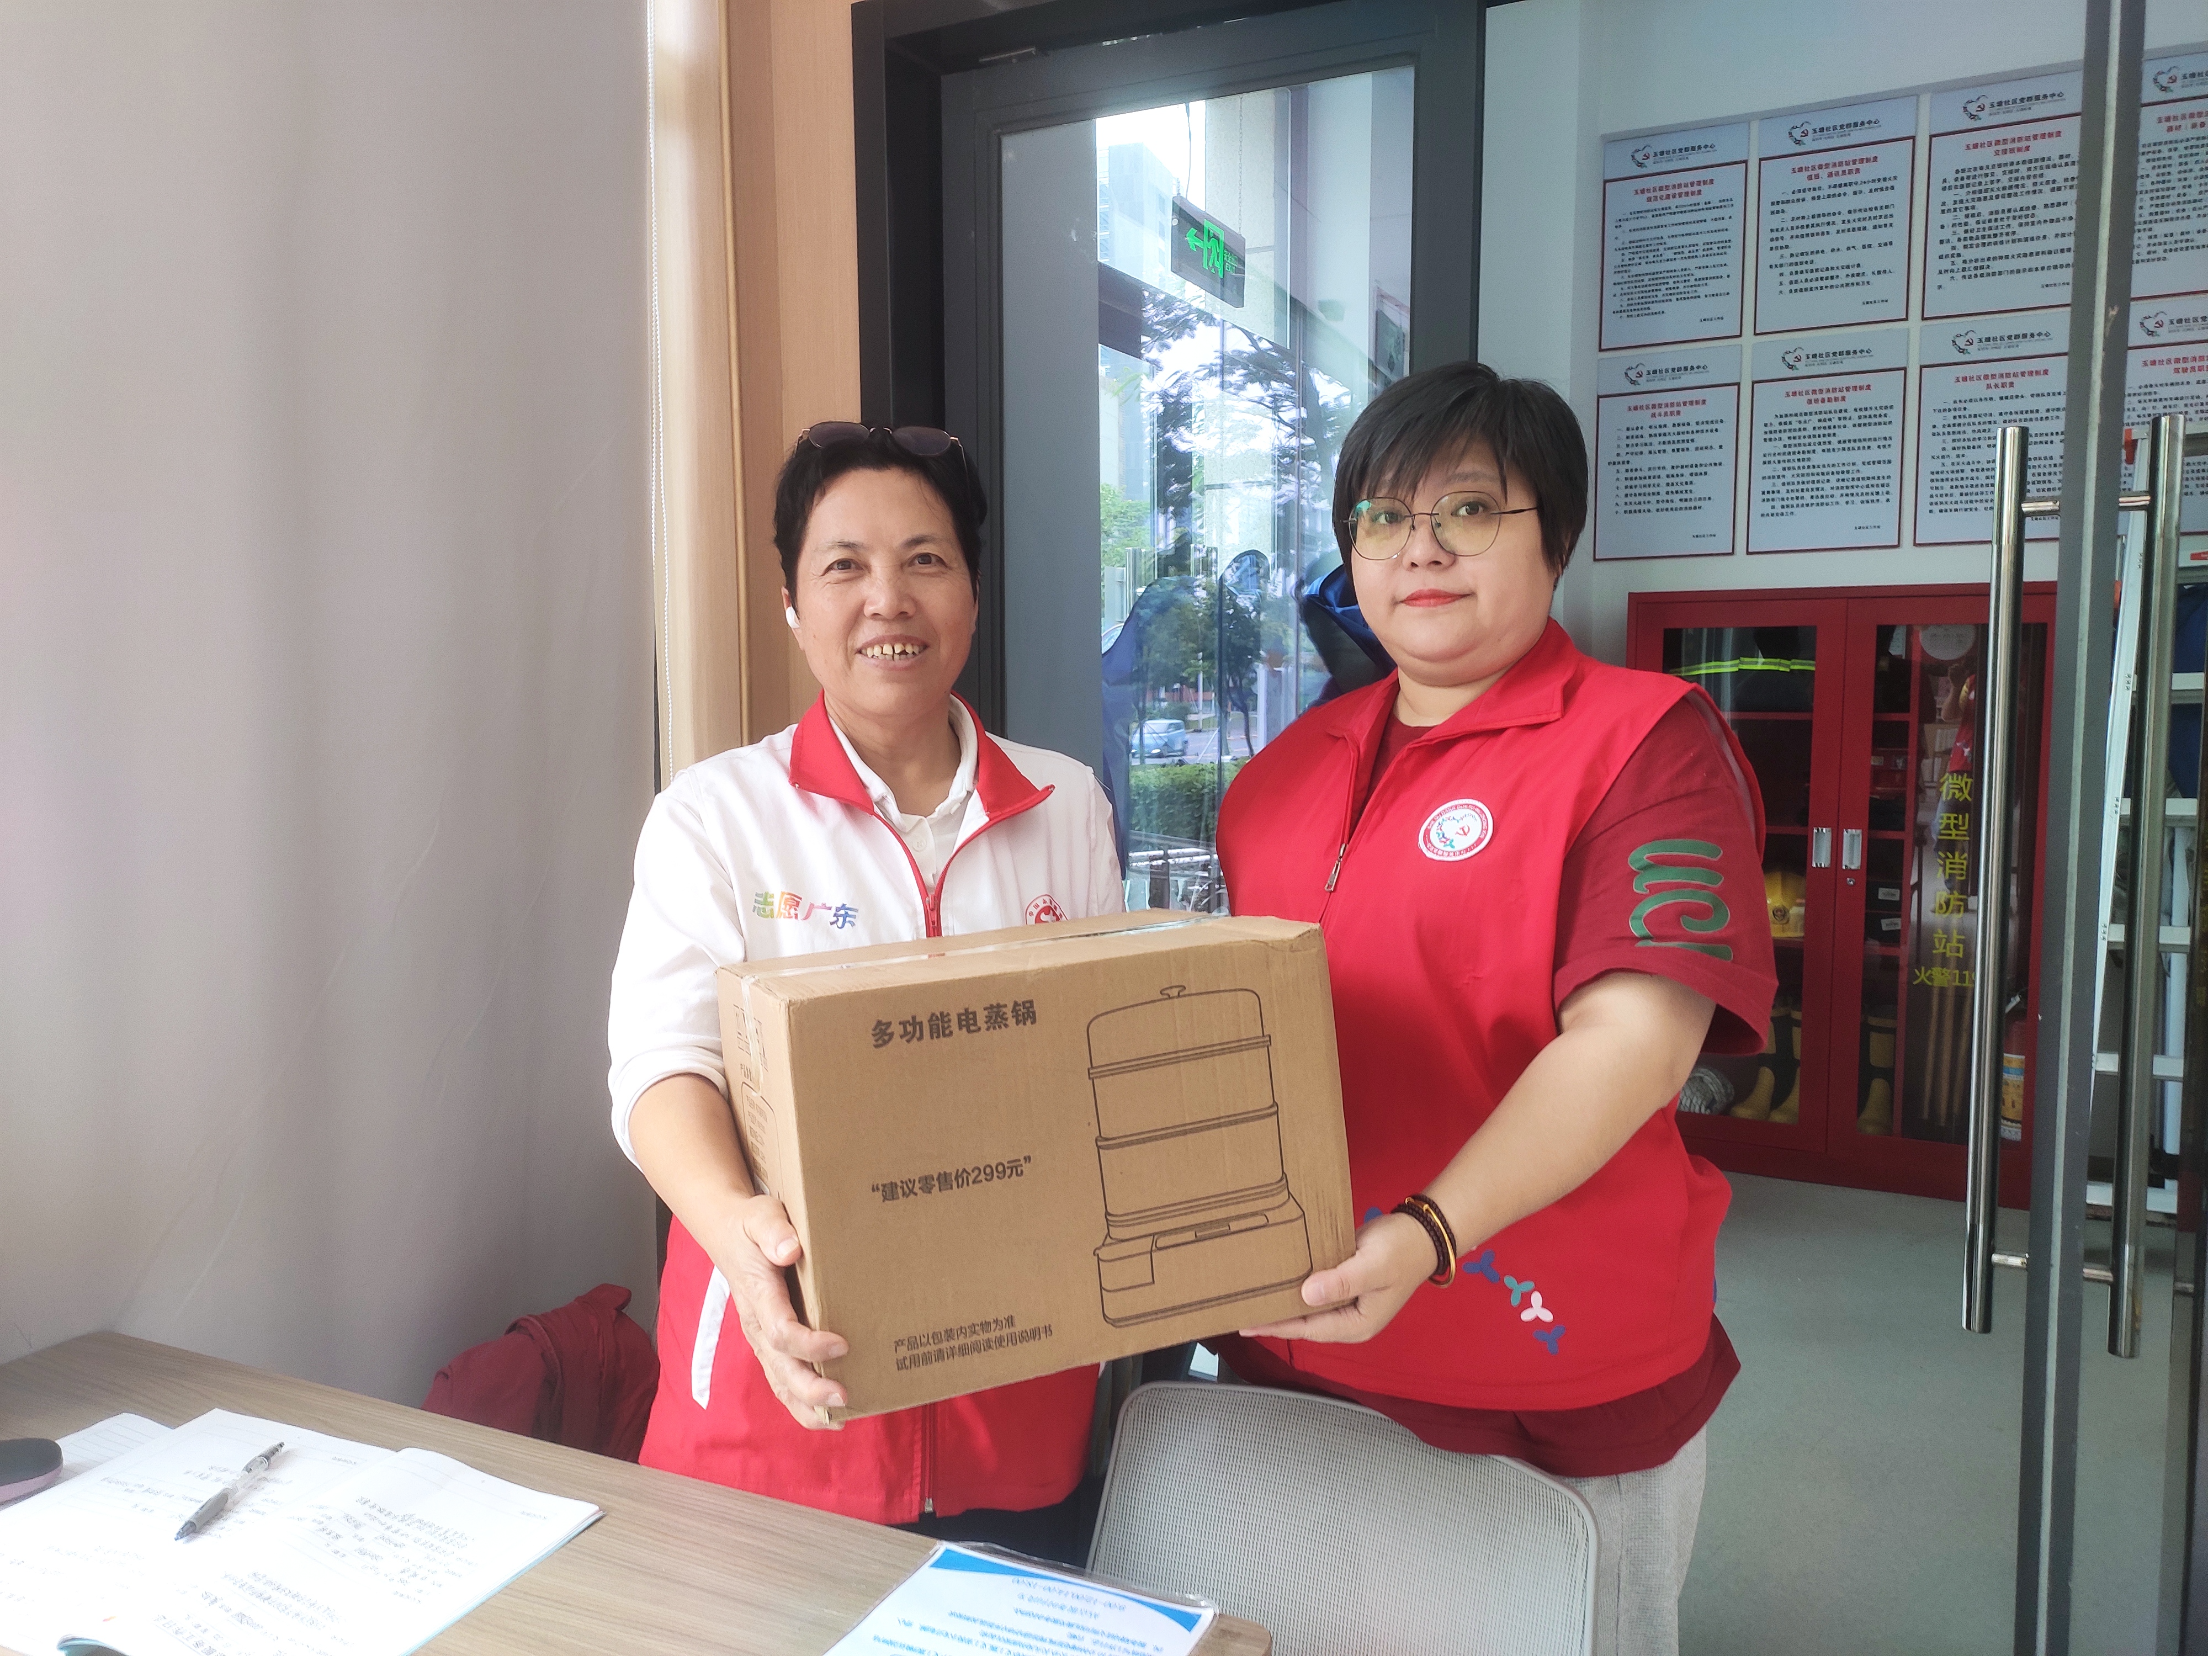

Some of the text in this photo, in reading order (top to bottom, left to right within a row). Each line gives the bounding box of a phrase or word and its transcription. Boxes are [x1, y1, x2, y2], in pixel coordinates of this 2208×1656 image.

[1989, 91, 2065, 109] 玉塘社区党群服务中心
[1976, 330, 2051, 344] 玉塘社区党群服务中心
[1932, 771, 1974, 959] 微型消防站
[752, 889, 860, 931] 志愿广东
[870, 996, 1039, 1050] 多功能电蒸锅
[870, 1154, 1034, 1204] “建议零售价299元”
[893, 1313, 1017, 1354] 产品以包装内实物为准
[895, 1324, 1053, 1372] 试用前请详细阅读使用说明书
